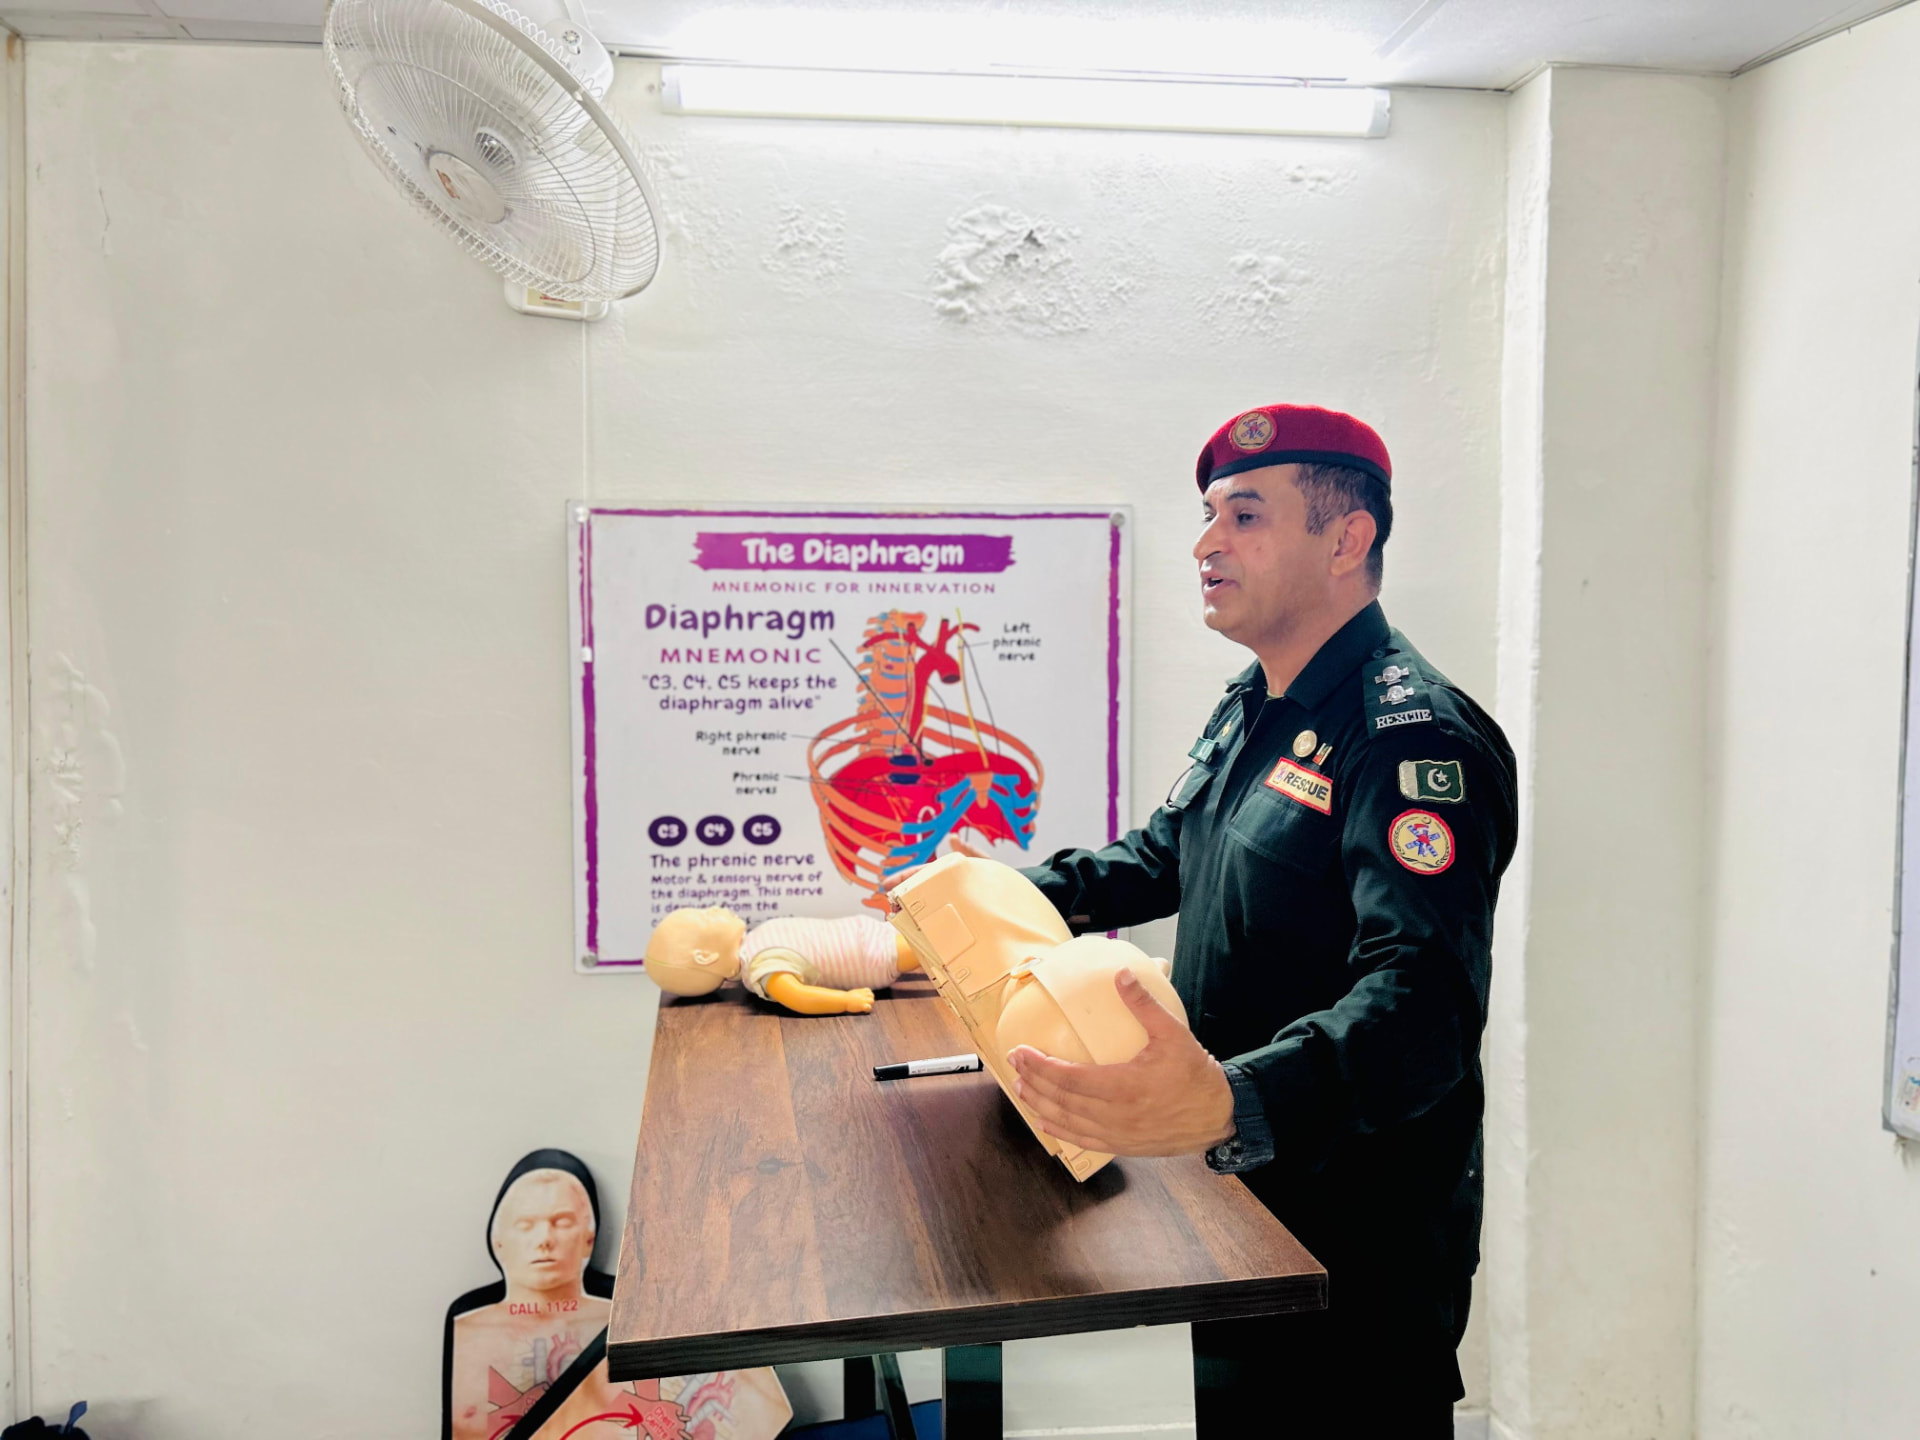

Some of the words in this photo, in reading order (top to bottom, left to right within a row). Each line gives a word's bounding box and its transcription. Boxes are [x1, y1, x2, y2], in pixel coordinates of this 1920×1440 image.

[741, 537, 795, 564] The
[803, 538, 965, 572] Diaphragm
[712, 582, 816, 593] MNEMONIC
[825, 583, 860, 593] FOR
[869, 583, 996, 594] INNERVATION
[645, 604, 835, 640] Diaphragm
[1003, 622, 1031, 634] Left
[993, 636, 1041, 651] phrenic
[660, 648, 821, 664] MNEMONIC
[998, 652, 1035, 662] nerve
[718, 674, 741, 690] C5
[747, 674, 800, 694] keeps
[806, 673, 838, 690] the
[660, 695, 762, 716] diaphragm
[769, 694, 821, 710] alive"
[1375, 709, 1433, 729] RESCUE
[696, 730, 732, 745] Right
[736, 730, 787, 745] phrenic
[722, 746, 760, 756] nerve
[733, 771, 779, 782] Phrenic
[736, 786, 777, 795] nerves
[1283, 771, 1329, 802] RESCUE
[657, 823, 680, 839] C3
[703, 822, 726, 838] C4
[751, 822, 774, 837] C5
[651, 854, 681, 868] The
[688, 853, 757, 871] phrenic
[764, 853, 815, 866] nerve
[651, 874, 692, 885] Motor
[697, 873, 707, 884] &
[712, 872, 761, 887] sensory
[766, 873, 804, 882] nerve
[808, 871, 823, 881] of
[651, 888, 673, 899] the
[758, 886, 781, 897] This
[786, 886, 823, 896] nerve
[651, 903, 661, 913] is
[757, 901, 779, 911] the
[509, 1302, 541, 1316] CALL
[547, 1300, 578, 1312] 1122
